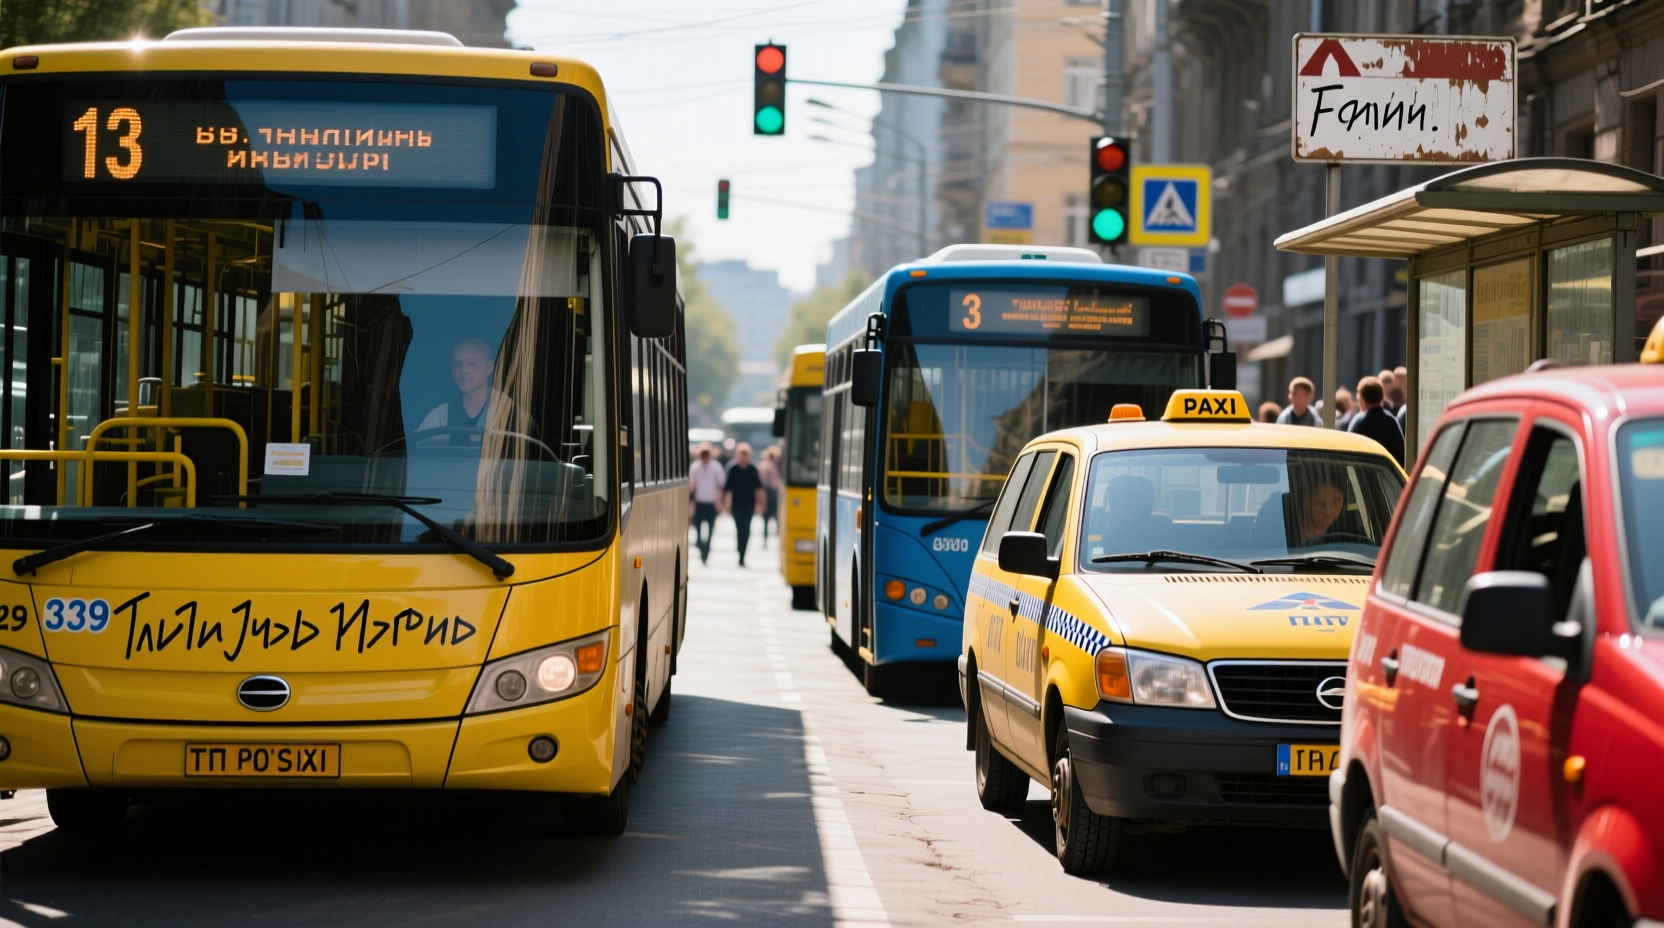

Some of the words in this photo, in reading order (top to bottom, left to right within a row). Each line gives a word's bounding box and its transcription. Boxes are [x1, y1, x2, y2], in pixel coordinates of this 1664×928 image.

[73, 107, 142, 179] 13
[962, 293, 982, 330] 3
[1184, 397, 1236, 415] PAXI
[45, 598, 109, 632] 339
